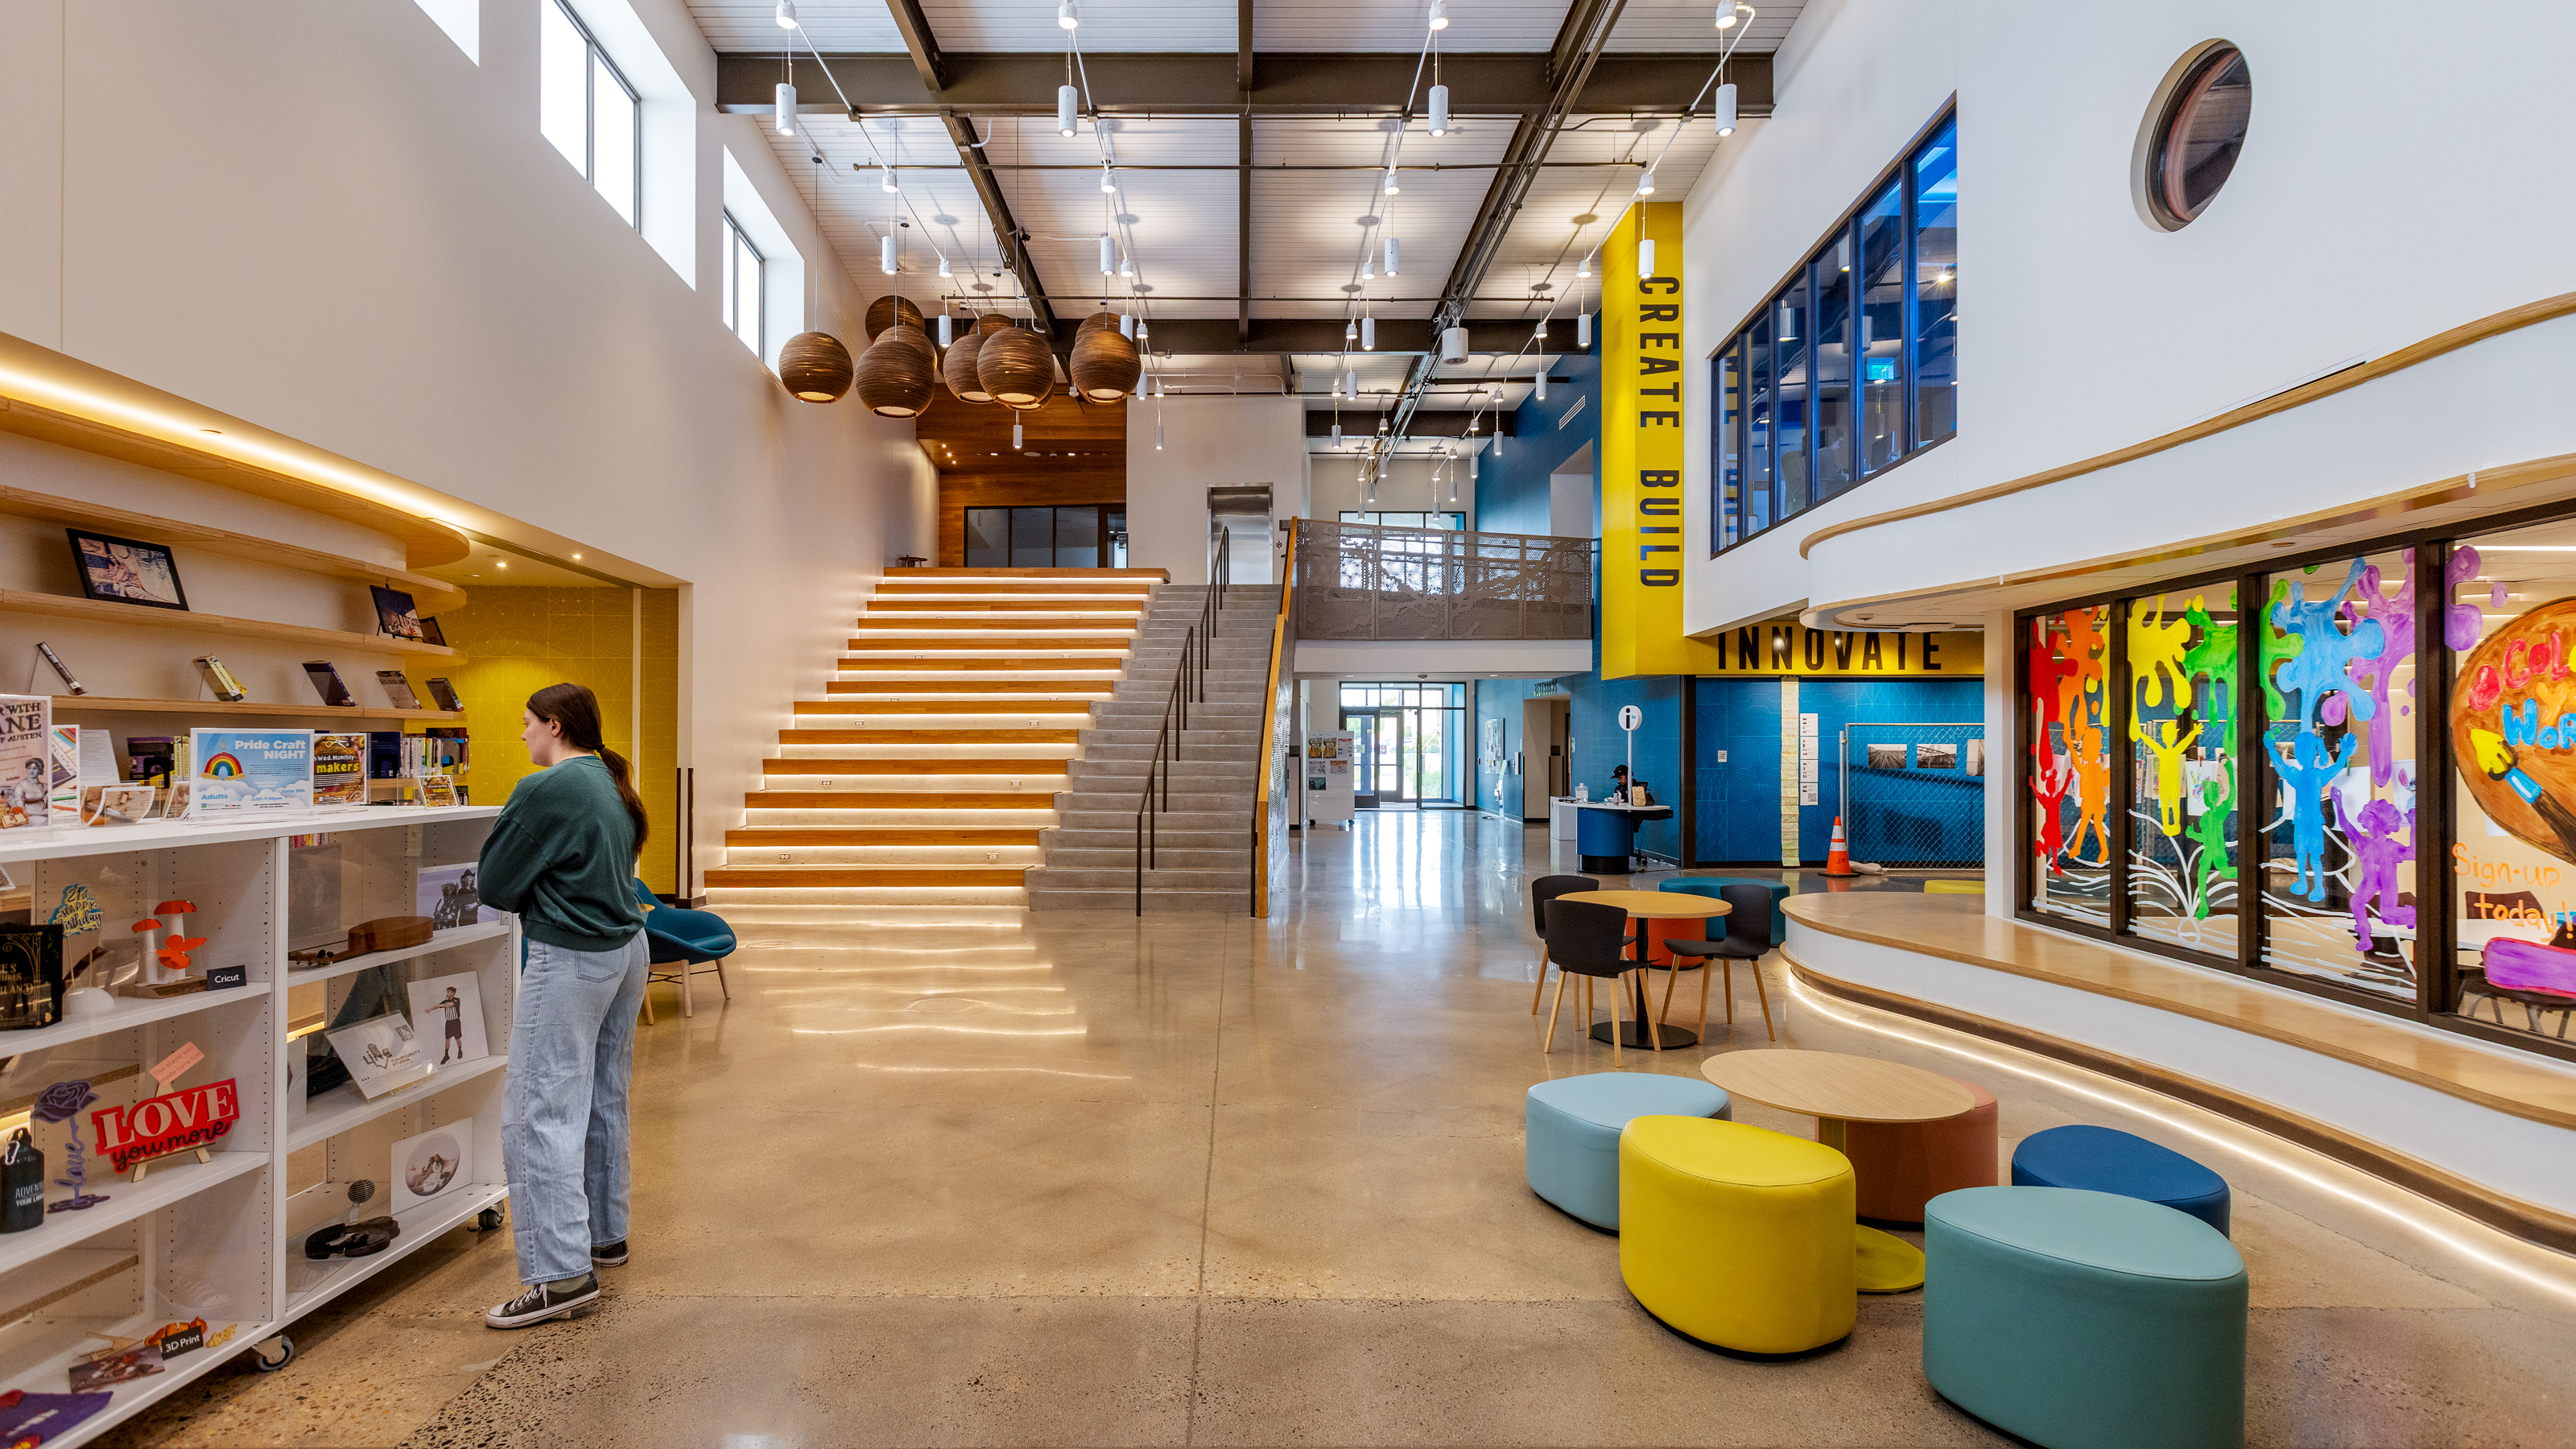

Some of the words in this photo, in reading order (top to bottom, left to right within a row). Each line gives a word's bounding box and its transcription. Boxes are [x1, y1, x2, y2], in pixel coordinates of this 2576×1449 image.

[1639, 276, 1680, 427] CREATE
[1872, 364, 1890, 378] EXIT
[1639, 469, 1680, 587] BUILD
[1718, 625, 1942, 671] INNOVATE
[5, 702, 42, 715] WITH
[7, 731, 42, 742] AUSTEN
[235, 740, 270, 749] Pride
[273, 740, 307, 749] Craft
[263, 750, 306, 760] NIGHT
[316, 762, 359, 773] makers
[2452, 842, 2562, 894] Sign-up
[68, 886, 89, 902] 21st
[62, 901, 95, 918] HAPPY
[2473, 893, 2574, 943] today!
[214, 973, 240, 983] Cricut
[165, 1053, 183, 1068] stand
[390, 1050, 420, 1063] COMMUNITY
[392, 1058, 410, 1067] STUDIO
[99, 1084, 234, 1150] LOVE
[113, 1140, 163, 1172] you
[167, 1121, 230, 1150] more
[16, 1197, 32, 1207] YOUR
[165, 1341, 180, 1352] 3D
[180, 1334, 200, 1348] Print
